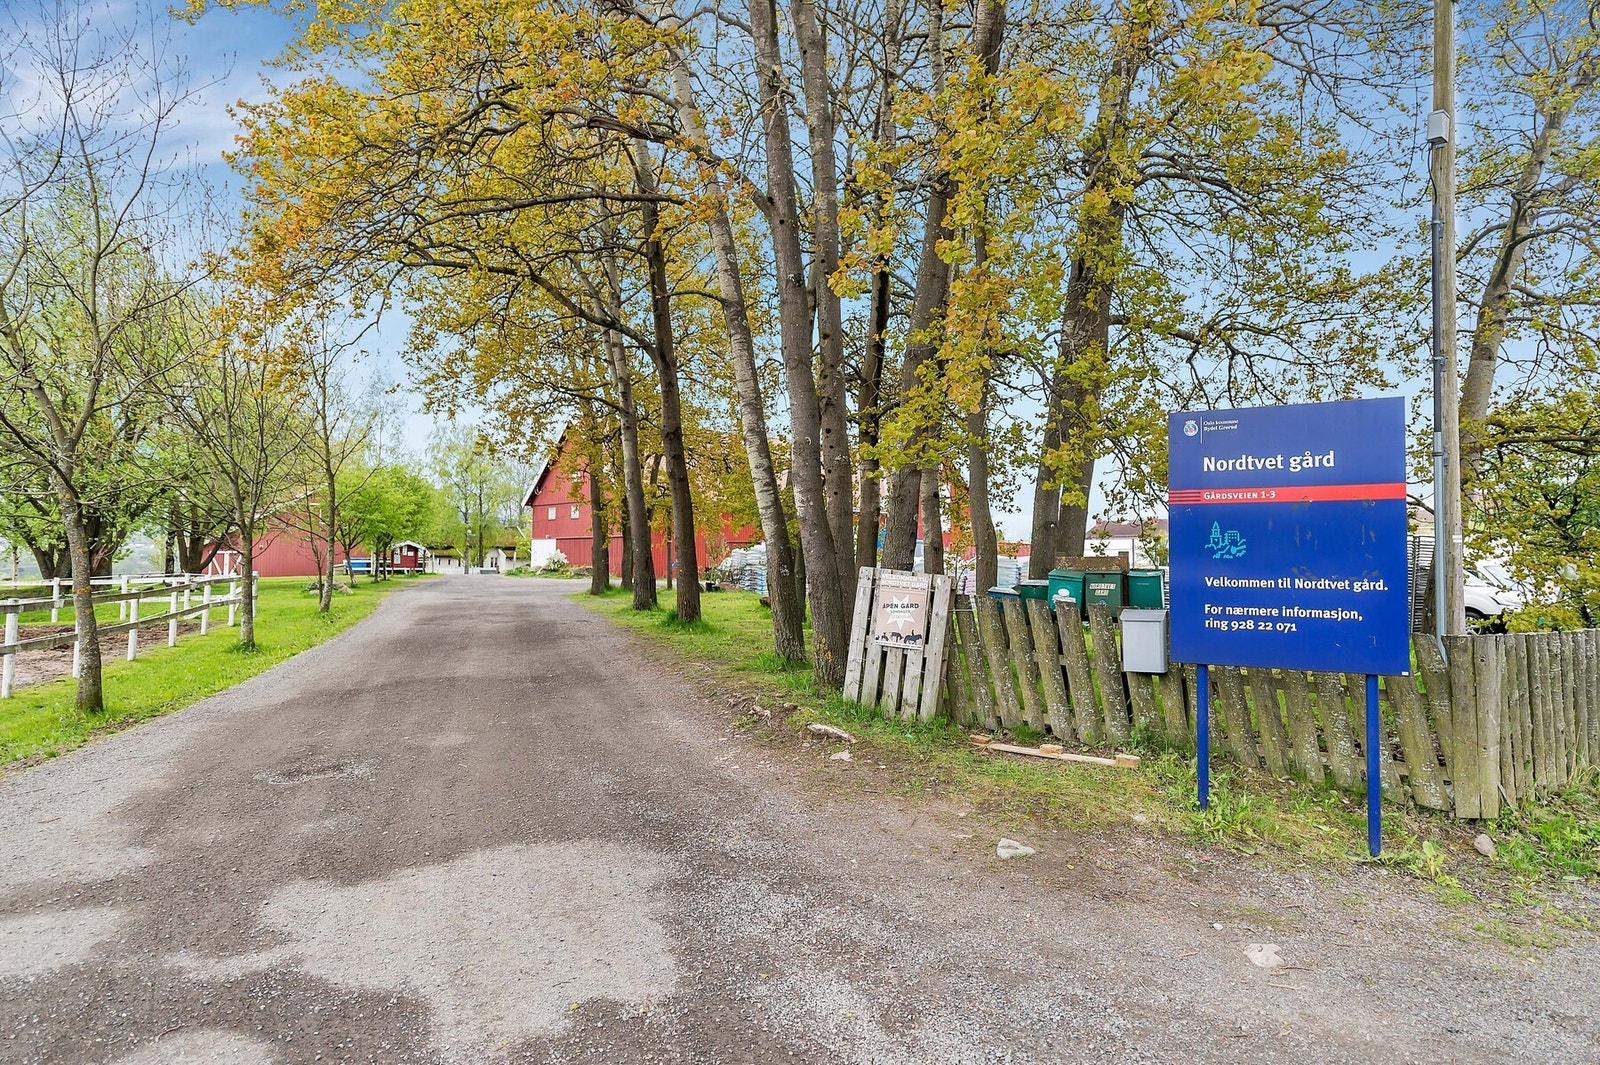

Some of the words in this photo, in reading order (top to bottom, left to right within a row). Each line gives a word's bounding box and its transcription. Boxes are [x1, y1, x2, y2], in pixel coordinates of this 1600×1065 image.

[1203, 454, 1284, 472] Nordtvet
[1289, 450, 1335, 472] gård
[1203, 490, 1258, 500] GÅRDSVEIEN
[1260, 490, 1276, 500] 1-3
[1204, 576, 1275, 589] Velkommen
[1278, 577, 1292, 589] til
[1294, 578, 1350, 590] Nordtvet
[1353, 577, 1388, 592] gård.
[1204, 604, 1223, 615] For
[1225, 606, 1279, 617] nærmere
[1282, 606, 1363, 621] informasjon,
[1205, 618, 1229, 631] ring
[1231, 619, 1255, 631] 928
[1257, 621, 1273, 631] 22
[1276, 621, 1297, 633] 071
